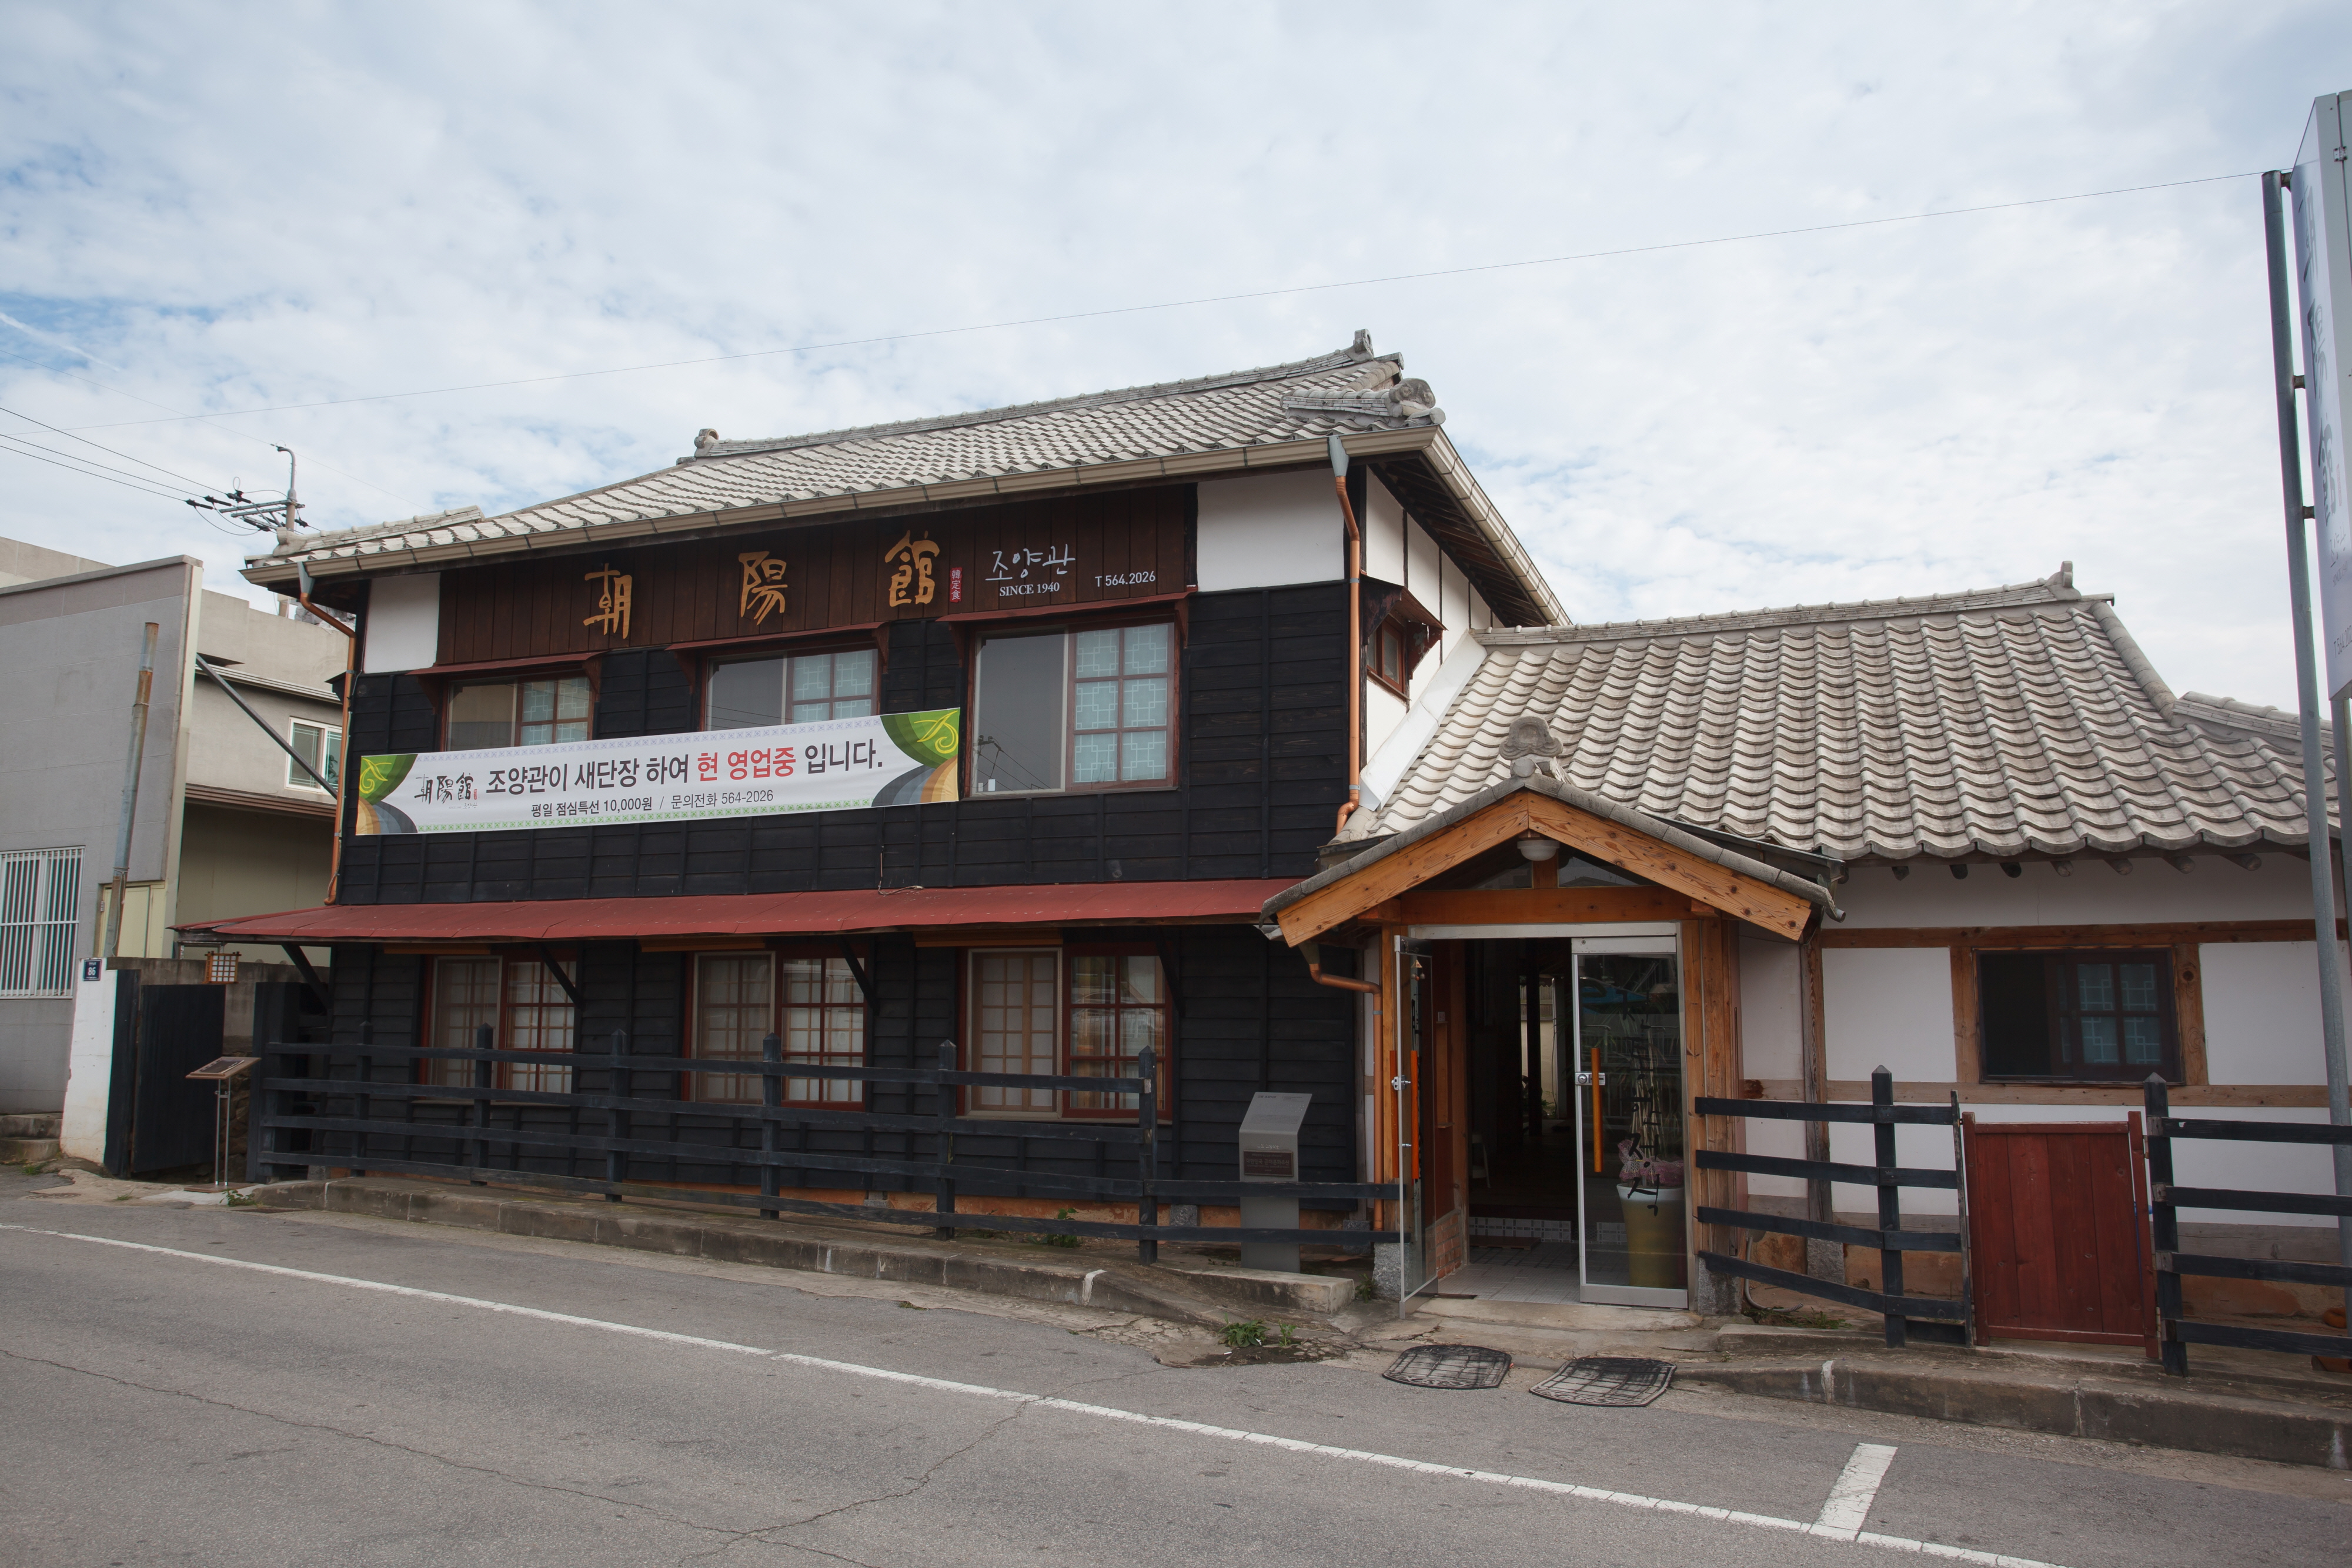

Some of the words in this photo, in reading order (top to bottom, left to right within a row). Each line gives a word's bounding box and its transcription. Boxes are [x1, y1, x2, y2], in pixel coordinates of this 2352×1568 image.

[985, 544, 1075, 581] 조양관
[951, 569, 961, 601] 韓定食
[1000, 584, 1034, 597] SINCE
[1037, 581, 1060, 593] 1940
[1095, 576, 1103, 587] T
[1105, 570, 1155, 586] 564.2026
[486, 763, 567, 795] 조양관이
[574, 758, 640, 790] 새단장
[646, 754, 689, 785] 하여
[697, 752, 718, 781] 현
[727, 747, 796, 780] 영업중
[804, 738, 883, 774] 입니다.
[531, 803, 552, 818] 평일
[556, 800, 599, 817] 점심특선
[603, 796, 652, 814] 10,000원
[671, 791, 718, 810] 문의전화
[721, 789, 774, 804] 564-2026
[88, 967, 96, 975] 86
